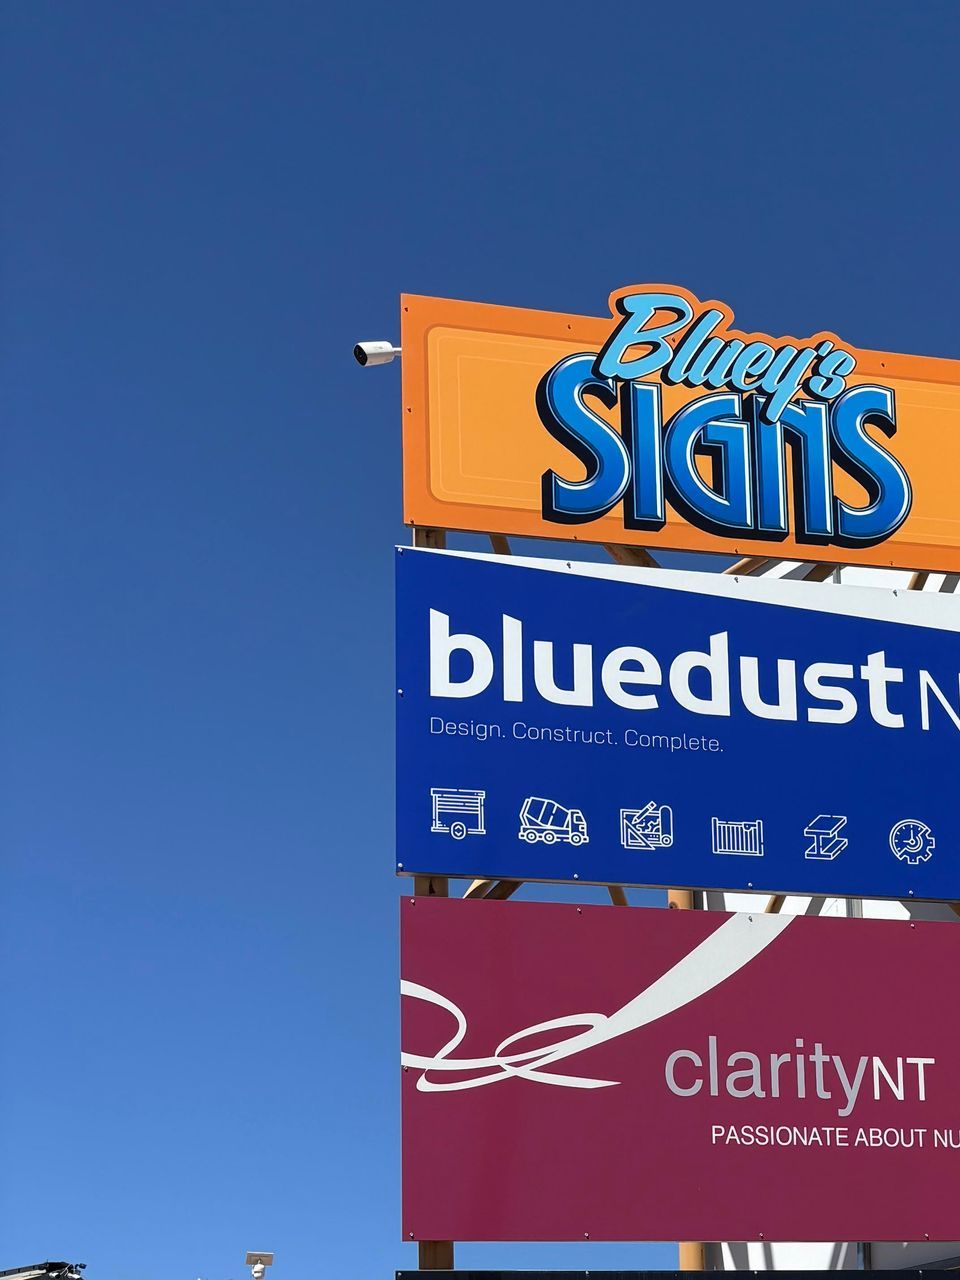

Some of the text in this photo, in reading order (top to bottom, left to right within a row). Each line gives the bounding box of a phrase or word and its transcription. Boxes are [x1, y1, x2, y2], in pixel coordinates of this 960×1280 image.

[599, 292, 857, 424] Bluey's
[429, 716, 725, 753] Design. Construct. Complete.
[711, 1124, 849, 1148] PASSIONATE
[854, 1126, 927, 1149] ABOUT
